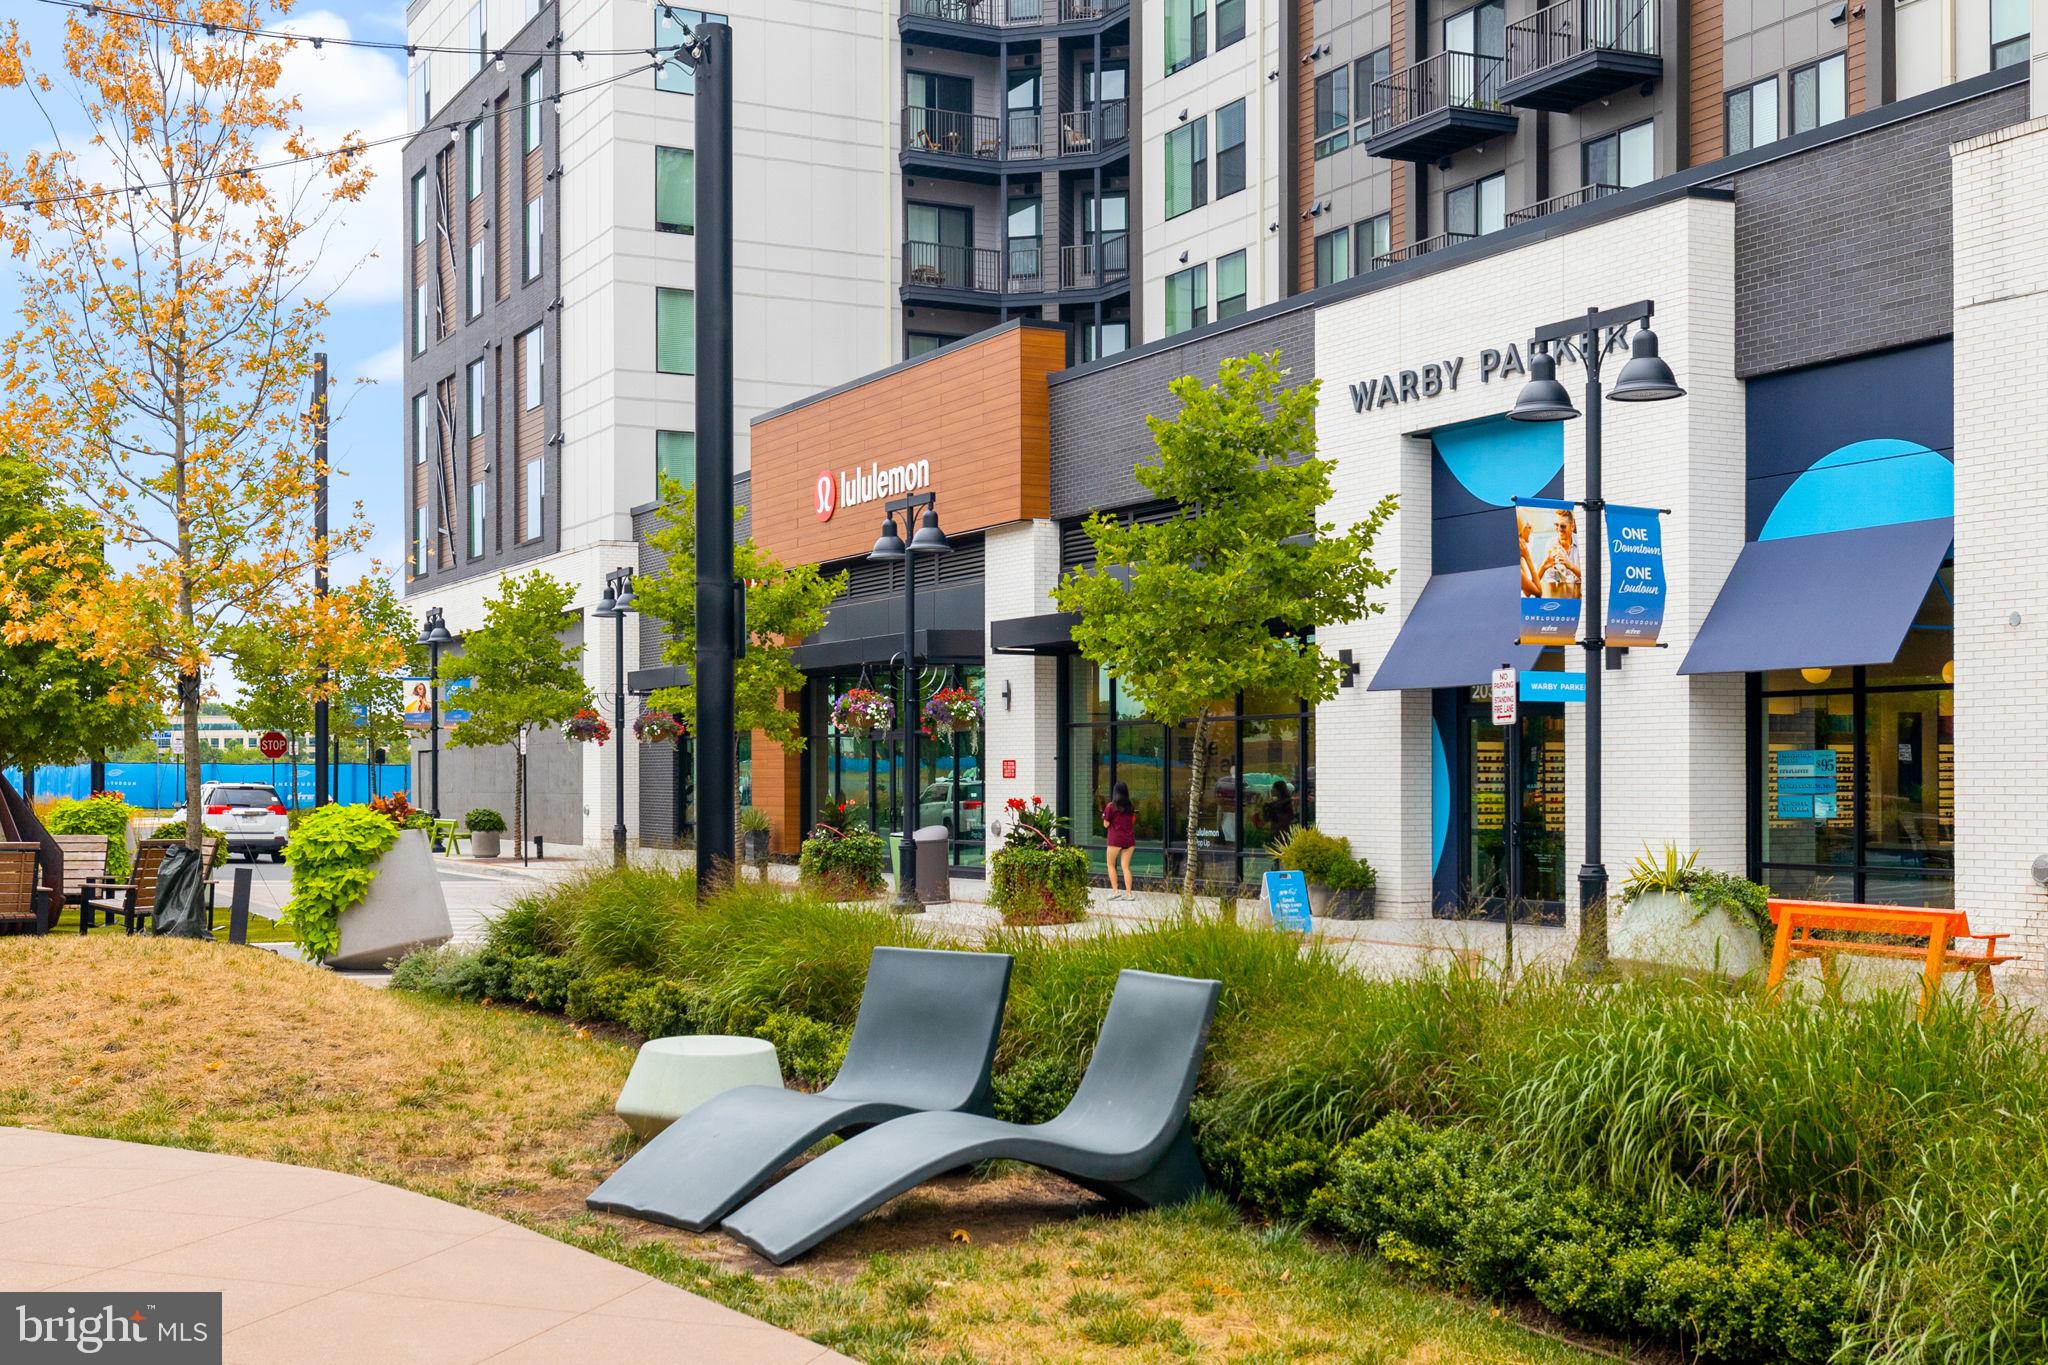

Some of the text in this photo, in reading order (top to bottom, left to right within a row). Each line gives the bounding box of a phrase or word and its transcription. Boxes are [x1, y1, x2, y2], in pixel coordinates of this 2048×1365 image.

[1349, 356, 1463, 414] WARBY
[840, 458, 930, 508] lululemon
[1621, 527, 1648, 541] ONE
[1613, 539, 1661, 556] Downtown
[1625, 566, 1652, 580] ONE
[1618, 579, 1660, 595] Loudoun
[1499, 673, 1508, 681] NO
[1493, 681, 1514, 689] PARKING
[1560, 683, 1586, 691] PARKE
[1494, 696, 1514, 704] STANDING
[1494, 704, 1514, 714] FIRE LANE
[261, 740, 286, 750] STOP
[1816, 758, 1834, 772] $95
[1196, 828, 1219, 838] ululemon
